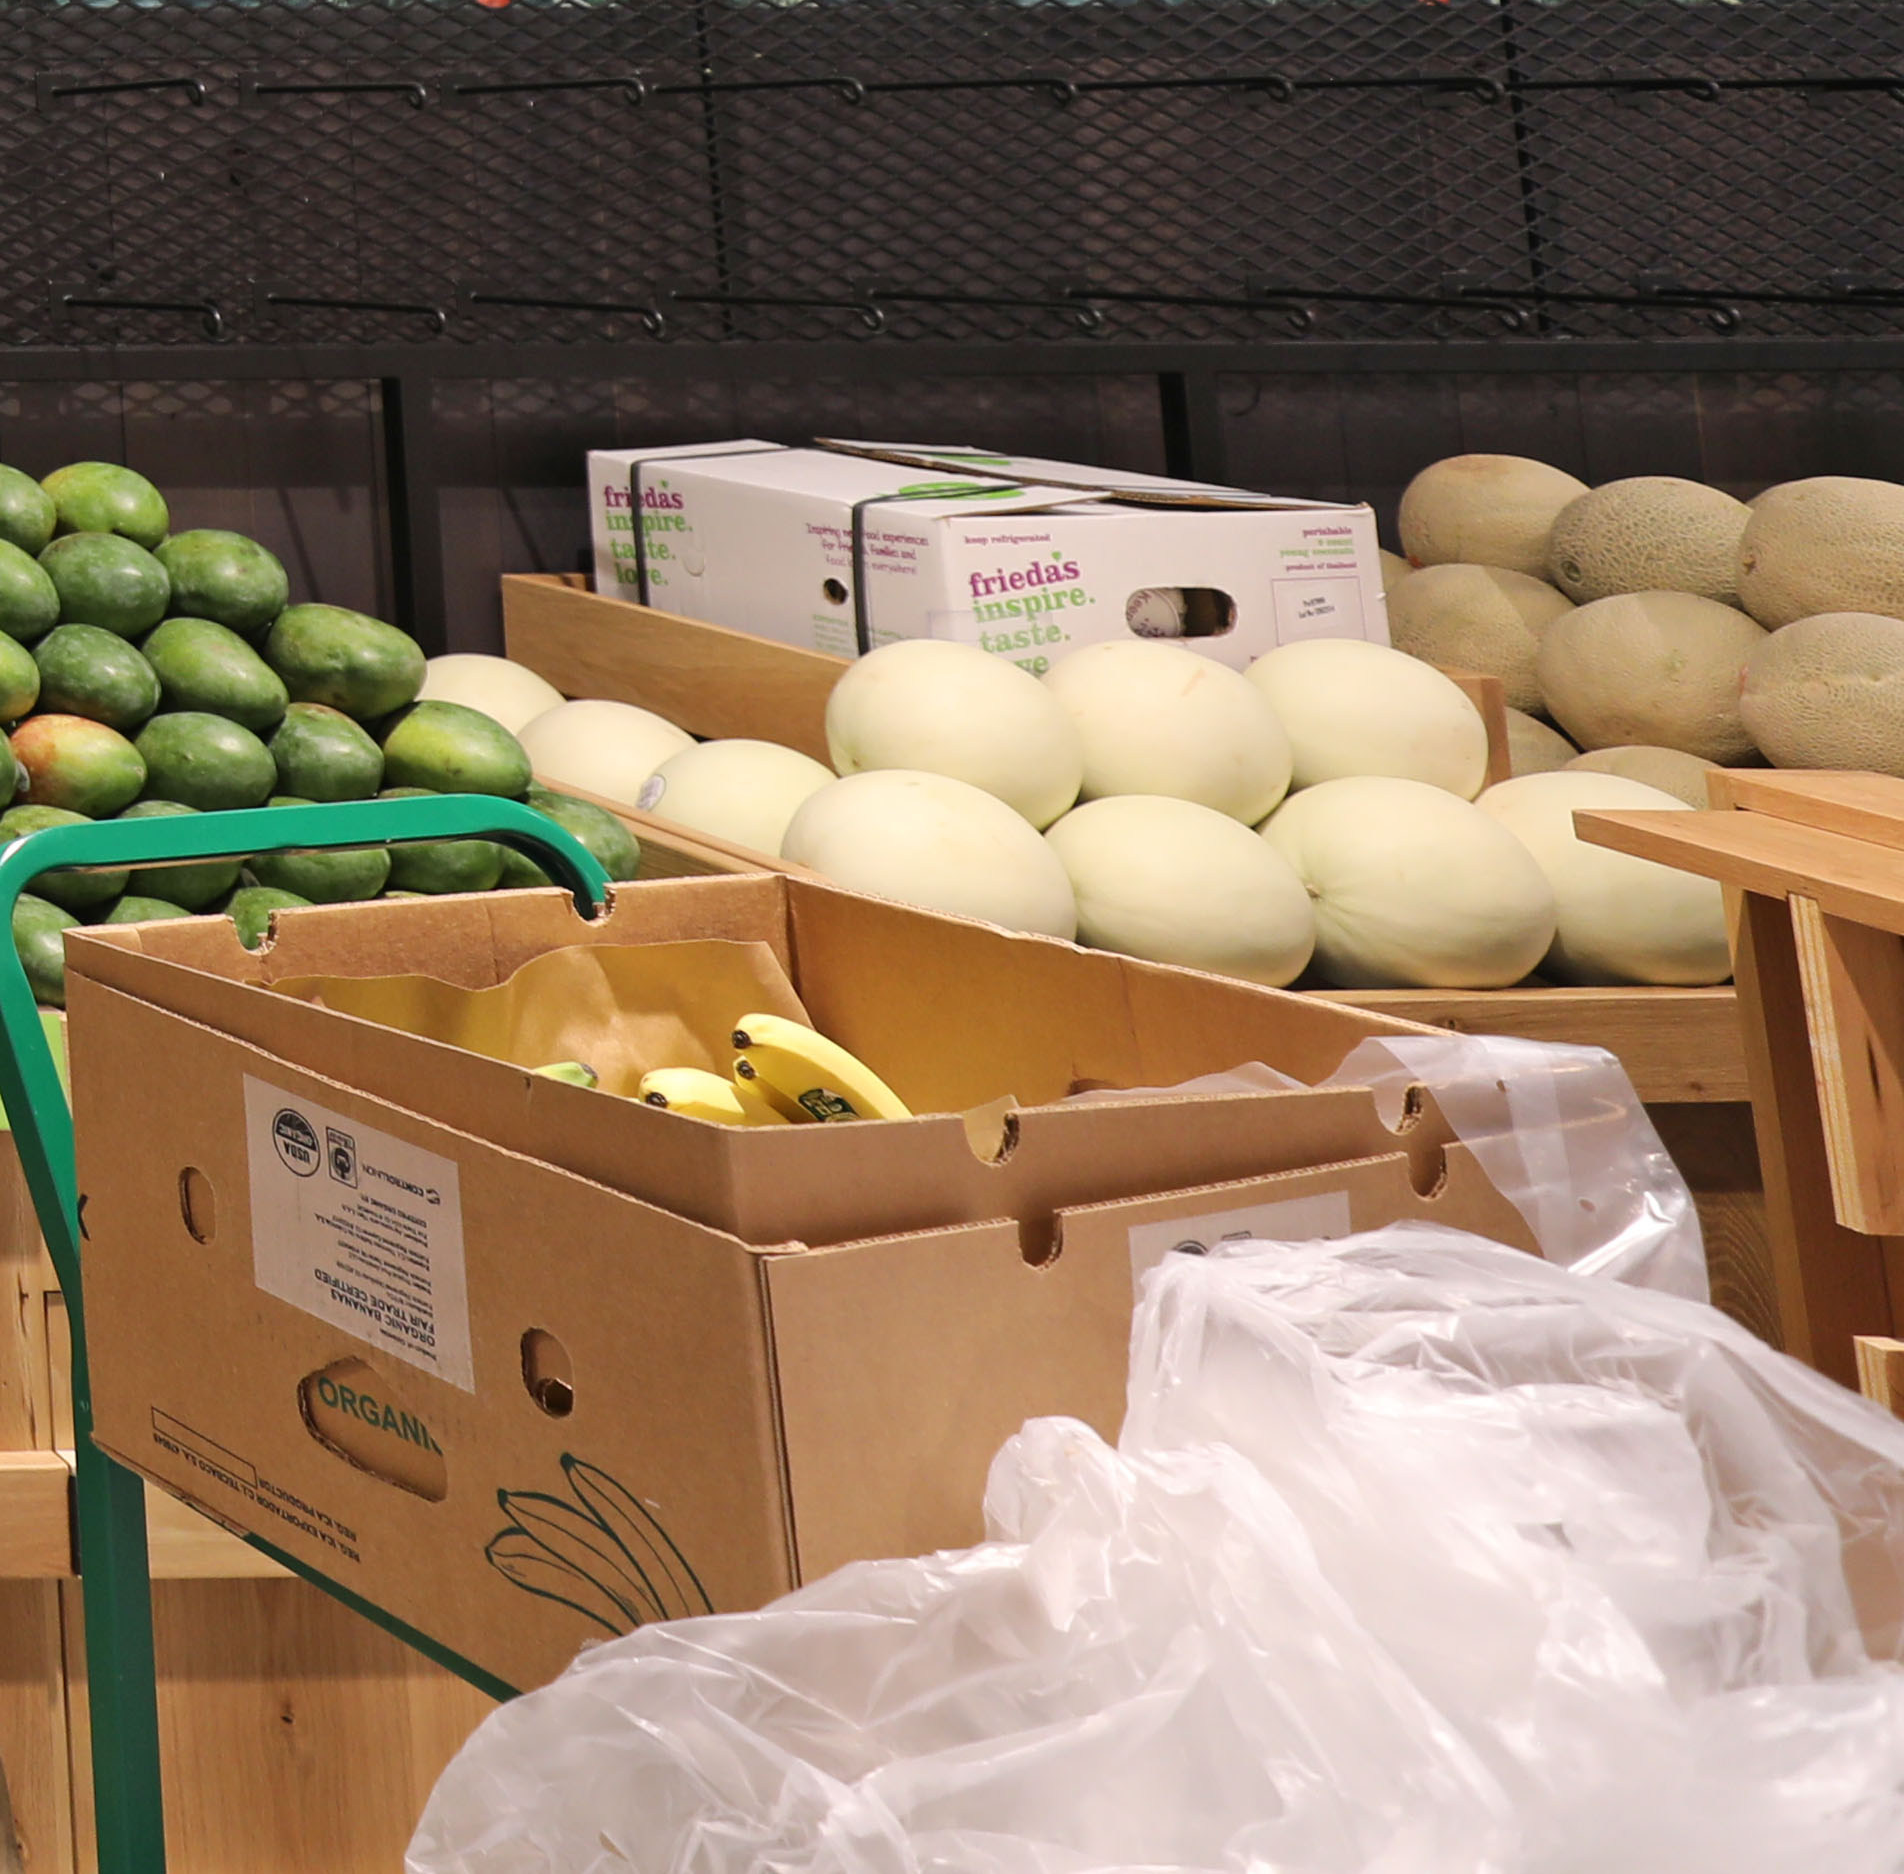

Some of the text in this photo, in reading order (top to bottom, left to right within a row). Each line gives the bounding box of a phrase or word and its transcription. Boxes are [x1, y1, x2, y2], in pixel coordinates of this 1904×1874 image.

[606, 509, 693, 538] inpire.
[1303, 527, 1352, 538] perishable
[610, 538, 676, 560] tate.
[964, 534, 1051, 545] keep refrigerated
[972, 587, 1096, 623] inspire.
[979, 622, 1071, 654] taste.
[283, 1139, 309, 1163] USDA
[314, 1267, 367, 1303] CERTIFIED
[330, 1287, 381, 1322] BANANAS
[371, 1294, 405, 1321] TRADE
[383, 1313, 435, 1348] ORGANIC
[409, 1312, 434, 1334] FAIR
